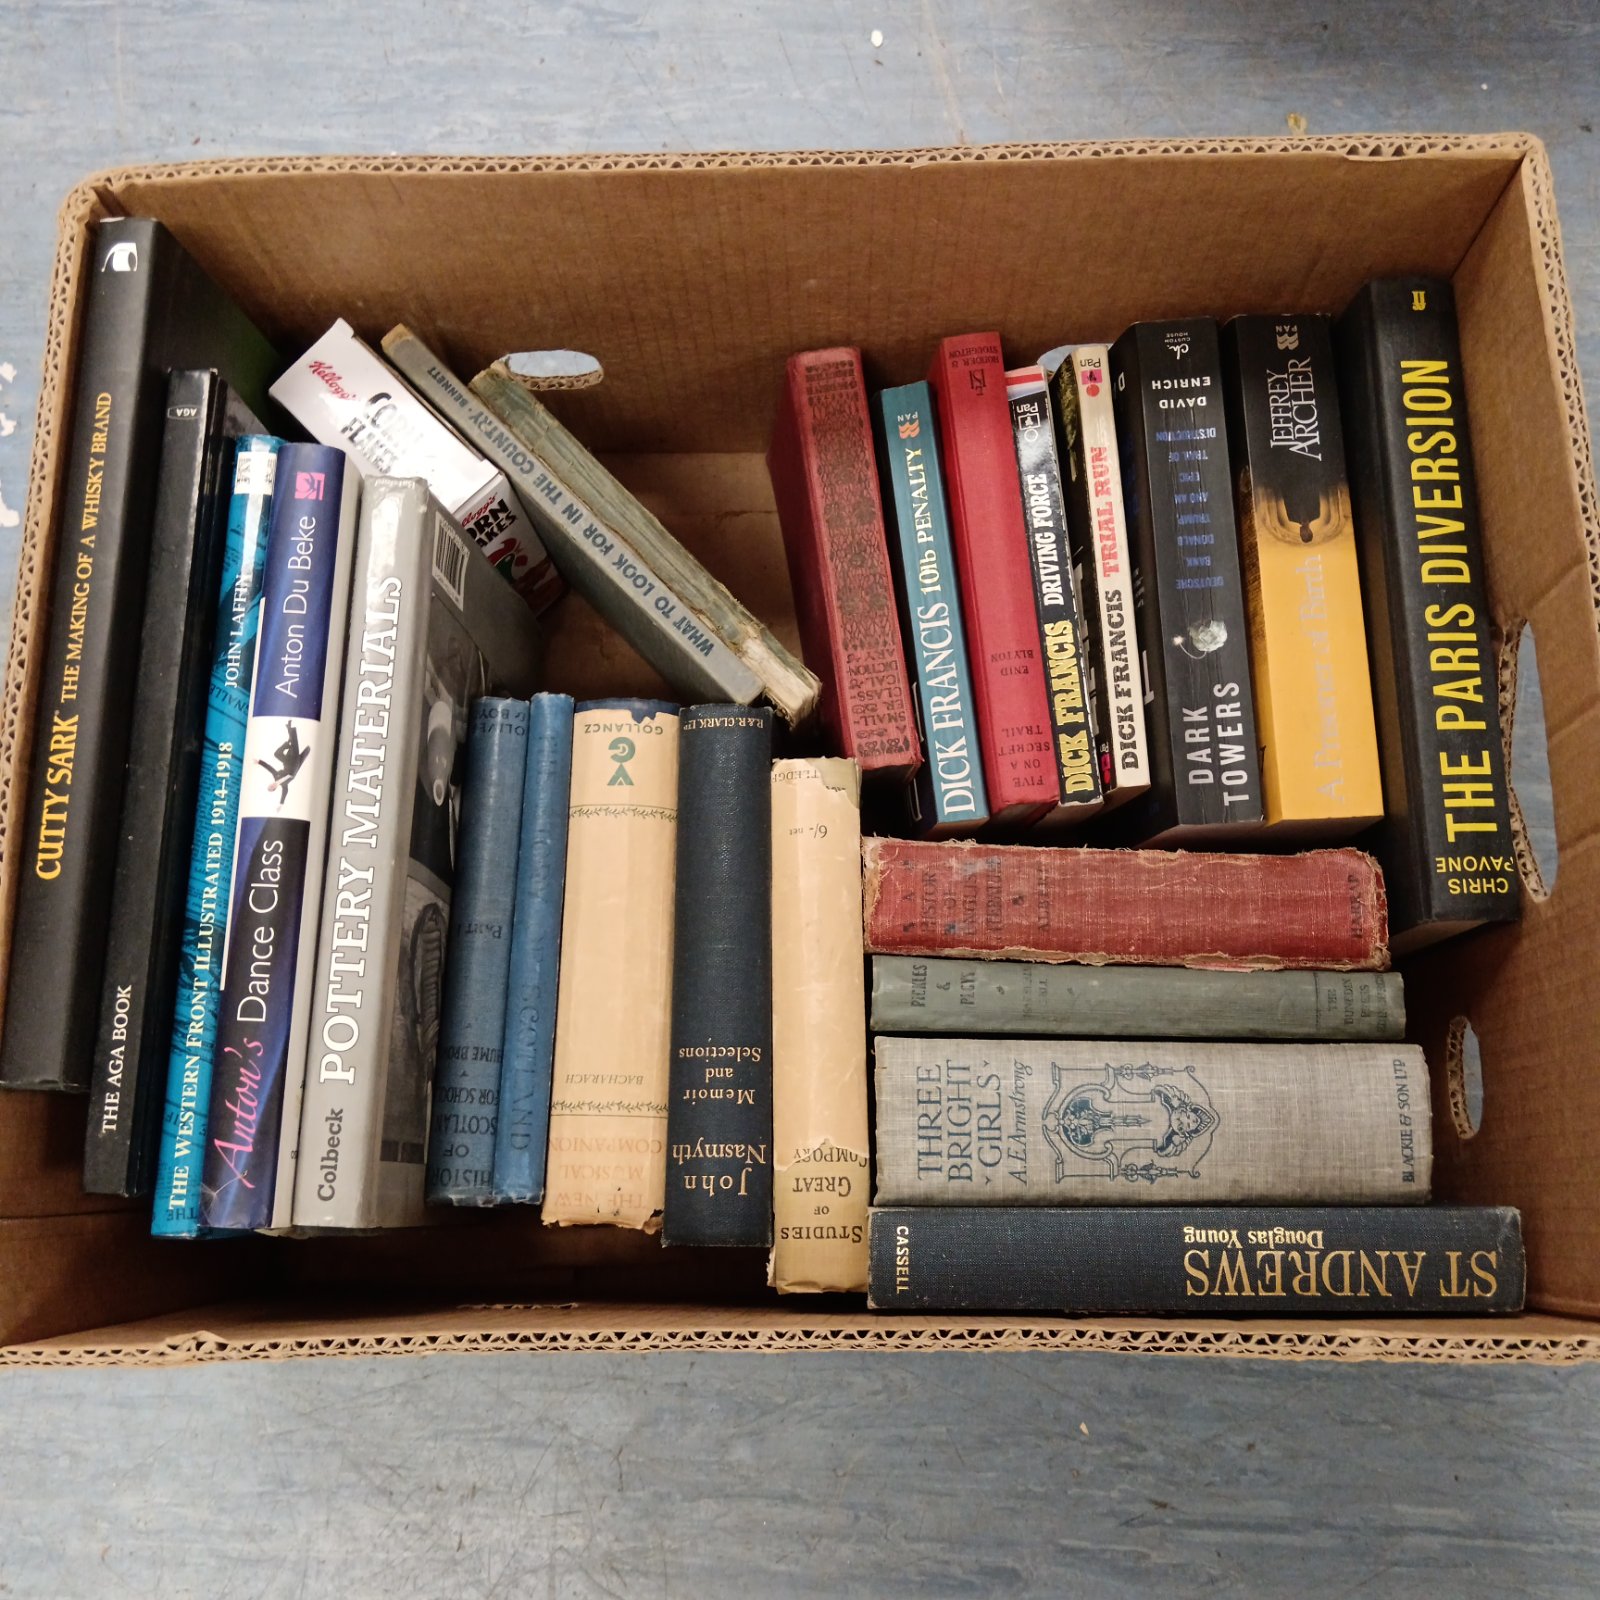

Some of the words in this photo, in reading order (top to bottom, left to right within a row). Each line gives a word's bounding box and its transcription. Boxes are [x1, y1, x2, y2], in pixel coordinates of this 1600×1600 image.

[1276, 325, 1298, 333] PAN
[949, 345, 999, 360] STOUGHTON
[1079, 358, 1101, 368] Pan
[427, 366, 467, 408] BENNETT
[1152, 376, 1211, 390] ENRICH
[1159, 396, 1207, 409] DAVID
[91, 392, 112, 453] BRAND
[175, 406, 198, 418] AGA
[897, 411, 919, 422] PAN
[1016, 401, 1039, 414] Pan
[1266, 368, 1295, 448] JEFFREY
[1288, 356, 1322, 461] ARCHER
[470, 408, 535, 475] COUNTRY
[533, 475, 563, 505] THE
[1090, 446, 1111, 498] RUN
[1178, 471, 1201, 483] EPIC
[1400, 360, 1471, 584] DIVERSION
[81, 458, 105, 532] WHISKY
[561, 502, 585, 521] IN
[905, 447, 934, 545] PENALTY
[1027, 473, 1056, 528] FORCE
[464, 498, 510, 542] ORN
[476, 513, 518, 547] AKES
[582, 523, 615, 554] FOR
[1097, 501, 1120, 578] TRIAL
[1177, 534, 1215, 546] DONALD
[86, 535, 97, 550] A
[287, 515, 316, 570] Beke
[77, 550, 93, 580] OF
[612, 552, 655, 592] LOOK
[1035, 531, 1065, 606] DRIVING
[1176, 576, 1224, 589] DEUTSCHE
[230, 574, 252, 637] LAFFIN
[282, 580, 310, 615] Du
[655, 593, 677, 617] TO
[66, 582, 90, 661] MAKING
[673, 613, 715, 656] WHAT
[225, 642, 242, 688] JOHN
[275, 624, 305, 698] Anton
[991, 649, 1035, 664] BLYTON
[1105, 589, 1132, 699] FRANCIS
[61, 662, 80, 703] THE
[917, 602, 964, 731] FRANCIS
[1000, 665, 1029, 678] ENID
[1044, 620, 1085, 726] FRANCIS
[1424, 603, 1487, 730] PARIS
[341, 576, 402, 849] MATERIALS
[584, 722, 664, 736] GOLLANCZ
[1001, 725, 1043, 738] TRAIL
[48, 713, 79, 785] SARK
[998, 742, 1050, 757] SECRET
[1114, 704, 1139, 770] DICK
[1182, 706, 1214, 785] DARK
[1213, 682, 1250, 806] TOWERS
[935, 736, 976, 816] DICK
[1010, 760, 1018, 771] A
[1012, 776, 1045, 788] FIVE
[1023, 758, 1041, 770] ON
[1059, 729, 1095, 795] DICK
[1318, 777, 1345, 805] A
[1439, 750, 1498, 843] THE
[36, 790, 69, 880] CUTTY
[249, 839, 284, 915] Class
[1448, 877, 1509, 894] CHRIS
[193, 832, 223, 973] ILLUSTRATED
[237, 926, 275, 1023] Dance
[319, 857, 375, 1085] POTTERY
[910, 963, 928, 1007] PICKLES
[936, 980, 951, 991] &
[112, 984, 132, 1041] BOOK
[185, 977, 209, 1049] FRONT
[106, 1044, 126, 1091] AGA
[679, 1046, 762, 1062] Selections
[565, 1073, 643, 1086] BACHARACH
[683, 1088, 755, 1105] Memoir
[705, 1068, 734, 1083] and
[101, 1092, 121, 1133] THE
[173, 1052, 201, 1161] WESTERN
[213, 1037, 264, 1189] Anton's
[1398, 1084, 1410, 1111] SON
[917, 1063, 943, 1181] THREE
[946, 1058, 974, 1183] BRIGHT
[976, 1073, 1002, 1168] GIRLS
[1400, 1112, 1412, 1127] &
[317, 1107, 344, 1203] Colbeck
[444, 1143, 470, 1158] OF
[672, 1137, 767, 1164] Nasmyth
[1402, 1127, 1415, 1184] BLACKIE
[167, 1166, 190, 1212] THE
[562, 1163, 644, 1181] MUSICAL
[684, 1167, 752, 1196] John
[792, 1175, 852, 1197] GREAT
[556, 1190, 599, 1207] NEW
[606, 1192, 646, 1209] THE
[813, 1205, 830, 1216] OF
[780, 1225, 863, 1244] STUDIES
[1183, 1226, 1242, 1249] Young
[1248, 1227, 1324, 1249] Douglas
[895, 1225, 910, 1294] CASSELL
[1183, 1250, 1427, 1297] ANDREWS
[1439, 1250, 1498, 1297] ST
